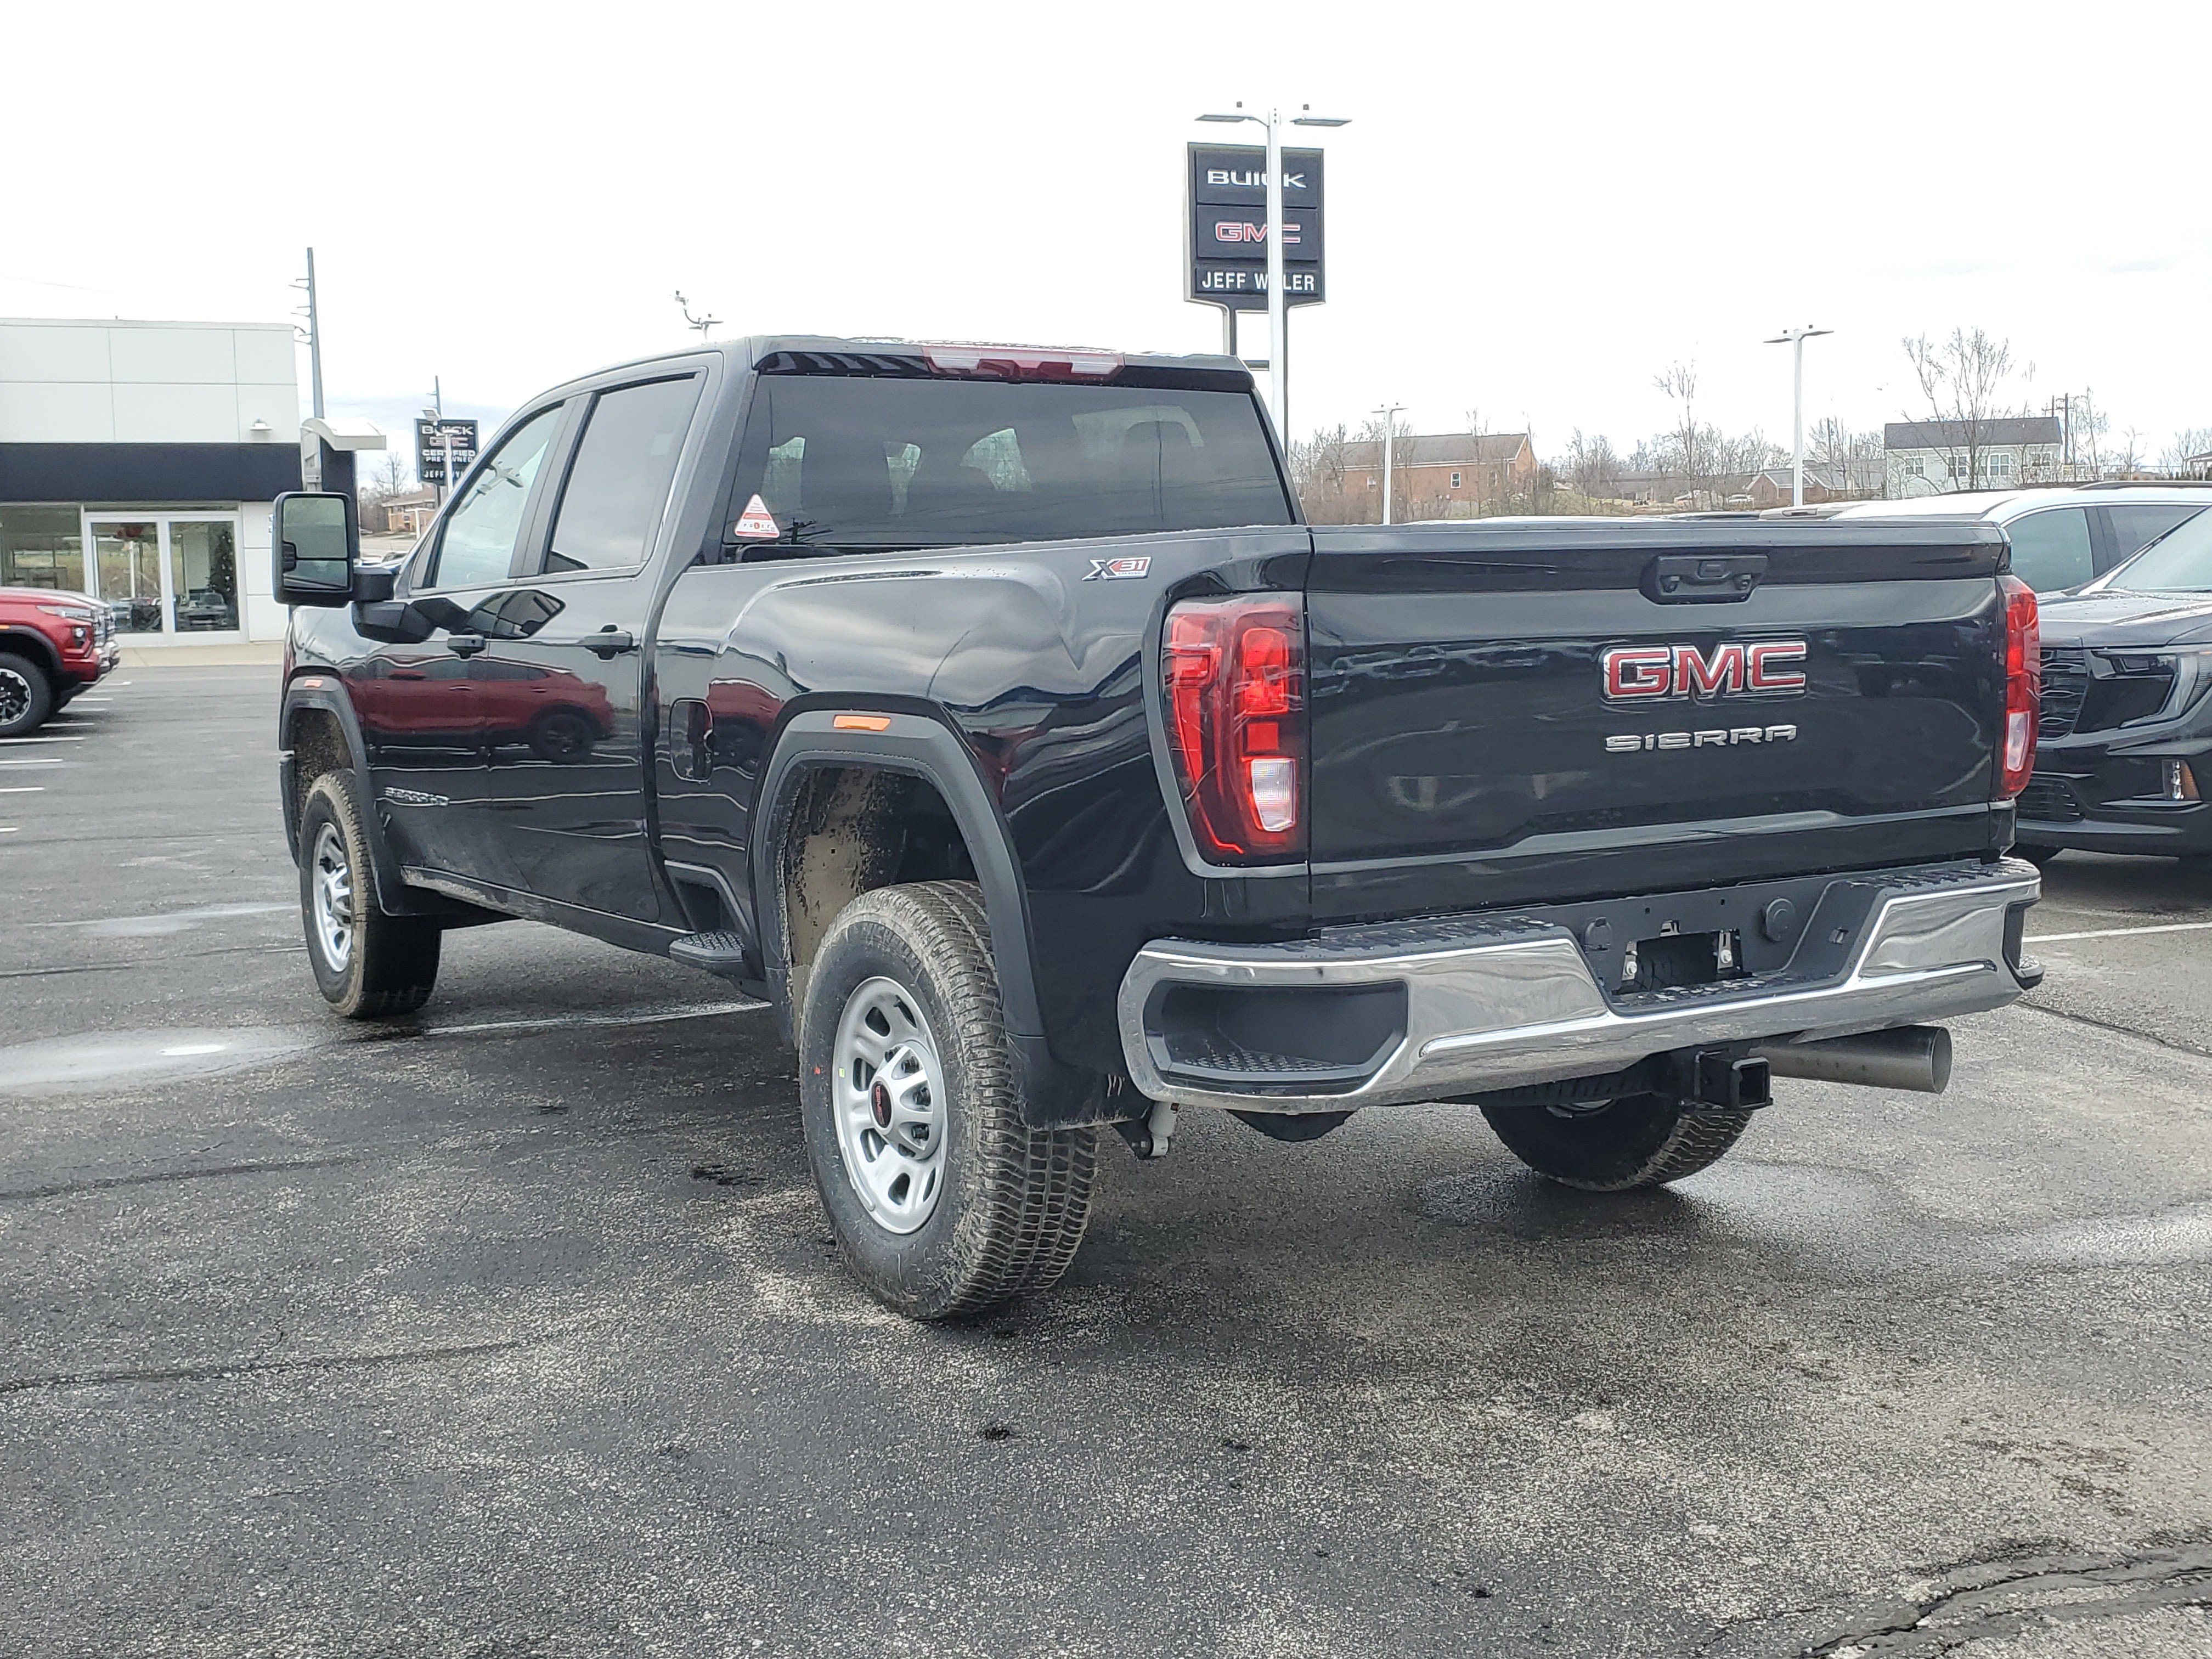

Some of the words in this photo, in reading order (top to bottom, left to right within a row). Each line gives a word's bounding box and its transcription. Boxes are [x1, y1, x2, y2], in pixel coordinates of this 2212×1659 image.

[1207, 169, 1307, 189] BUIK
[1201, 271, 1246, 289] JEFF
[1254, 273, 1314, 291] WLER
[424, 470, 444, 478] JEFF
[1082, 557, 1150, 580] X31
[1602, 641, 1807, 699] GMC
[1605, 724, 1797, 752] SIERRA
